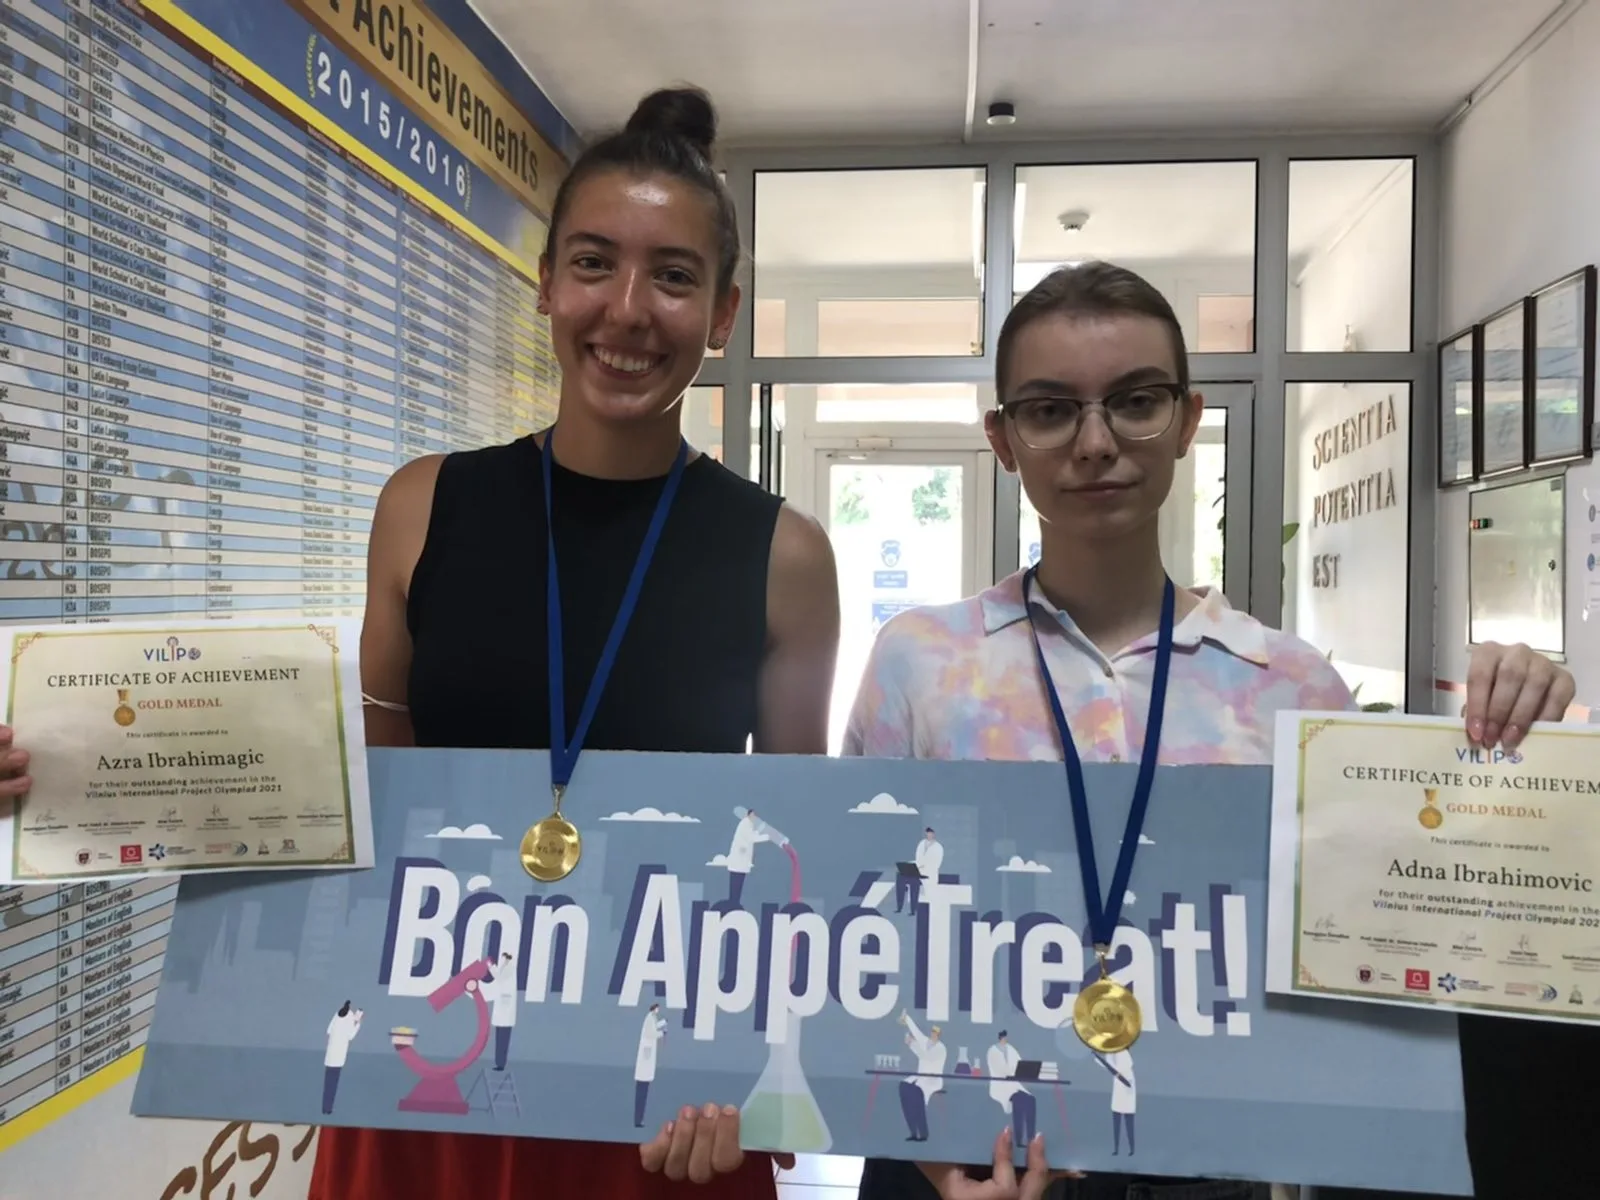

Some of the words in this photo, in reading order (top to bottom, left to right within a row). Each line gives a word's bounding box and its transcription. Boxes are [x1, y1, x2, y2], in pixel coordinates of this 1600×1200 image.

[353, 0, 539, 191] Achievements
[317, 52, 468, 197] 2015/2016
[1312, 394, 1397, 471] SCIENTIA
[1312, 467, 1397, 529] POTENTIA
[1312, 553, 1341, 589] EST
[47, 672, 151, 688] CERTIFICATE
[156, 671, 176, 684] OF
[182, 667, 300, 684] ACHIEVEMENT
[137, 699, 173, 710] GOLD
[176, 697, 222, 708] MEDAL
[97, 754, 143, 770] Azra
[147, 748, 265, 769] Ibrahimagic
[89, 781, 104, 789] for
[105, 780, 128, 788] their
[131, 778, 188, 788] outstanding
[190, 775, 247, 785] achievement
[249, 775, 258, 783] in
[260, 774, 276, 783] the
[1343, 766, 1463, 787] CERTIFICATE
[1469, 775, 1493, 788] OF
[85, 791, 117, 799] Vilnius
[119, 788, 179, 797] International
[180, 787, 213, 796] Project
[215, 784, 256, 795] Olympiad
[259, 784, 282, 793] 2021
[1446, 802, 1488, 815] GOLD
[1492, 805, 1547, 819] MEDAL
[1449, 838, 1492, 849] certificate
[1503, 843, 1539, 852] awarded
[1387, 859, 1447, 880] Adna
[1454, 863, 1593, 892] Ibrahimovic
[1372, 900, 1409, 911] Vilnius
[1412, 903, 1481, 918] International
[1484, 909, 1522, 922] Project
[1525, 912, 1575, 927] Olympiad
[1379, 889, 1394, 897] for
[1398, 891, 1423, 900] their
[1427, 894, 1494, 908] outstanding
[1497, 900, 1565, 913] achievement
[1568, 905, 1579, 914] in
[1582, 906, 1599, 915] the
[384, 862, 589, 1004] Bon
